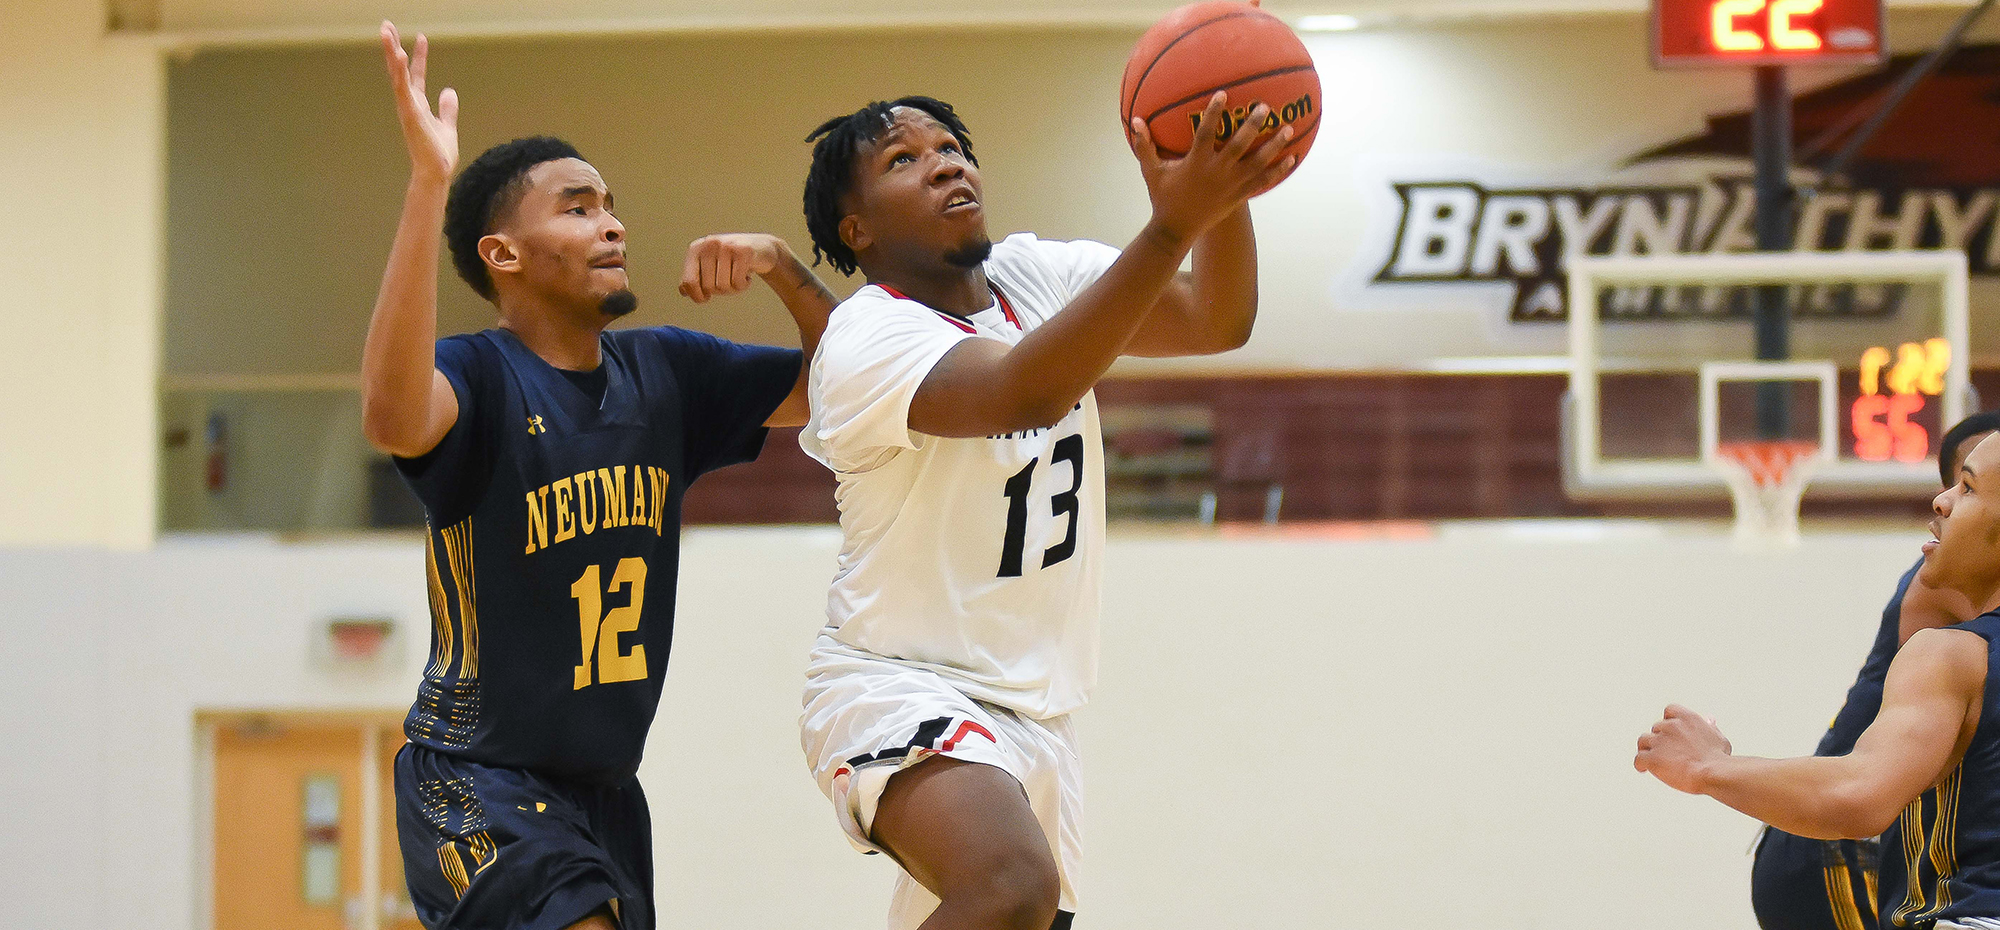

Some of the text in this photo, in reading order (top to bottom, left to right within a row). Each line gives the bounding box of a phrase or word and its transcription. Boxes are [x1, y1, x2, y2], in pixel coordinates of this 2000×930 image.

[1187, 93, 1312, 140] Wison
[1706, 184, 2000, 266] ATHY
[996, 433, 1084, 578] 13
[571, 557, 648, 690] 12
